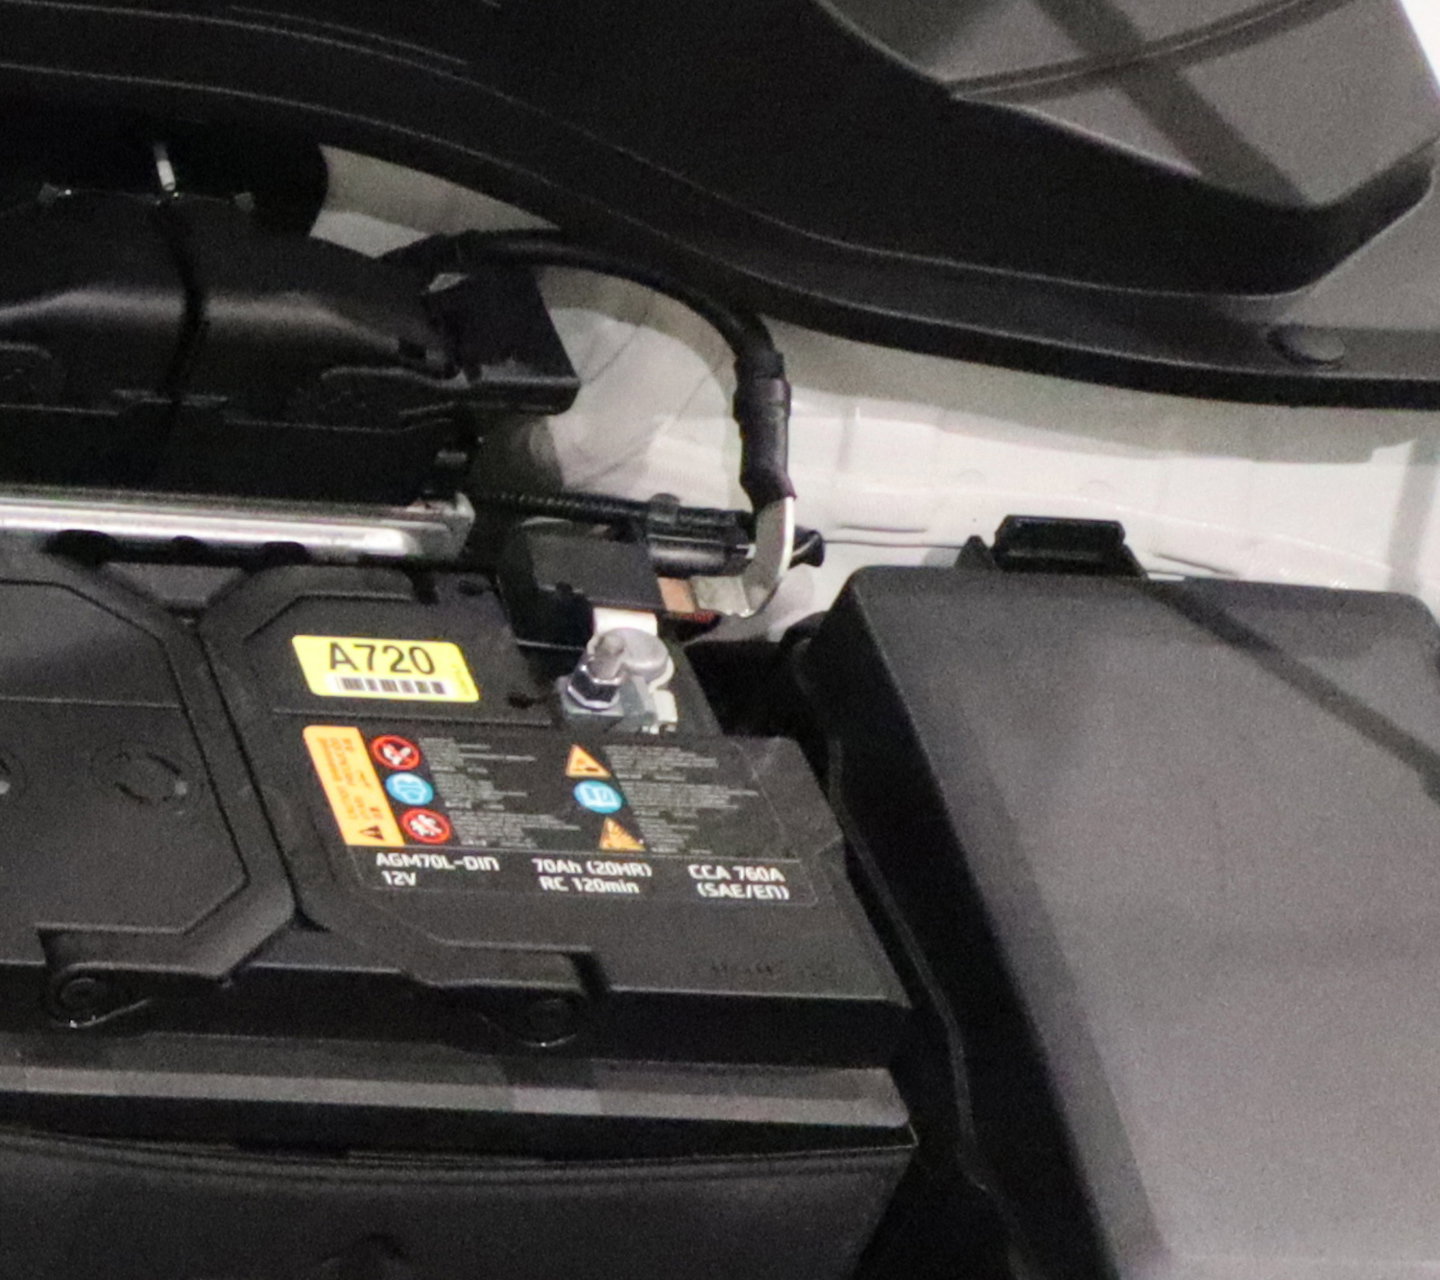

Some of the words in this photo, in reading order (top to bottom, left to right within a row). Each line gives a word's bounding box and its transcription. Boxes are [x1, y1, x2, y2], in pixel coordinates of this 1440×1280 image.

[329, 641, 436, 675] A720
[531, 858, 581, 875] 70Ah
[585, 860, 653, 879] (20HR)
[687, 864, 730, 882] CCA
[733, 865, 786, 883] 760A
[381, 870, 418, 888] 12V
[539, 875, 569, 892] RC
[572, 876, 640, 894] 120min
